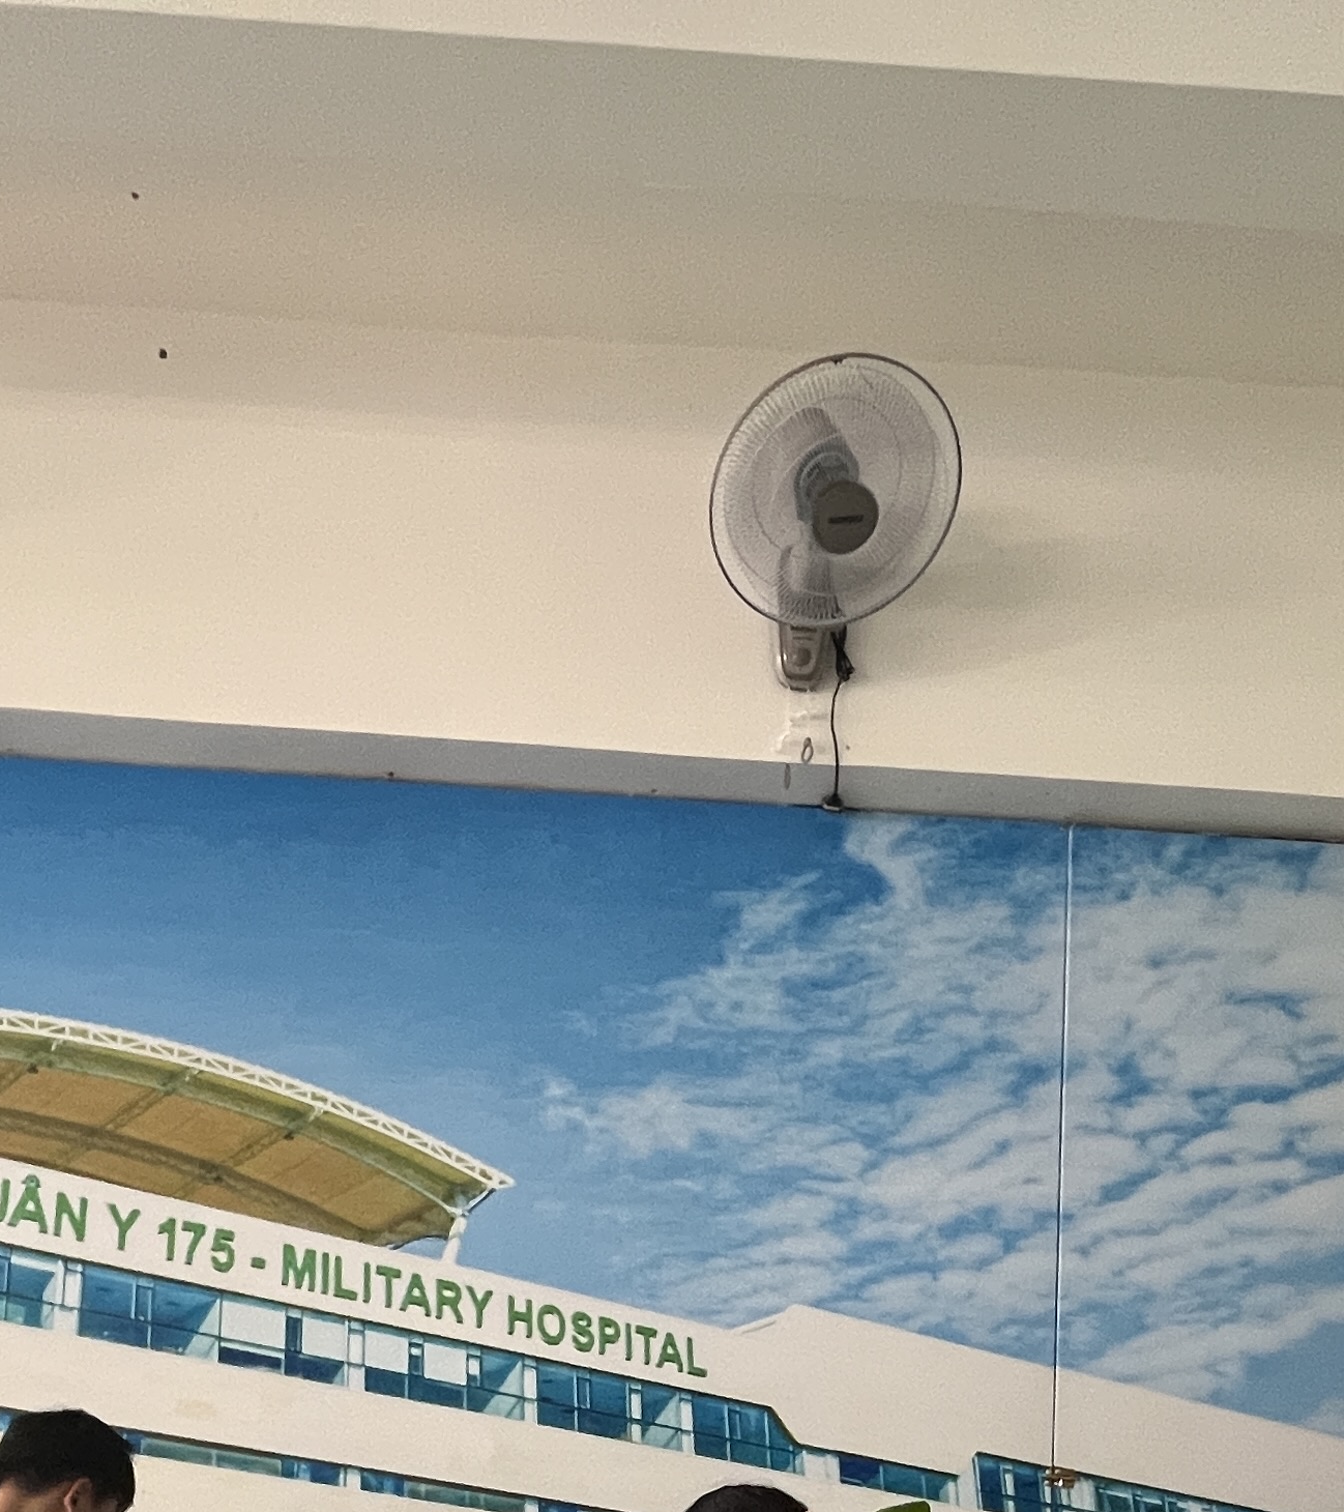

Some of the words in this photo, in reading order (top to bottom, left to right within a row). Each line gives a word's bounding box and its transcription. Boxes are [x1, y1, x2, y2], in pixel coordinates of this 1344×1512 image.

[105, 1202, 141, 1251] Y
[156, 1217, 237, 1273] 175
[280, 1243, 494, 1329] MILITARY
[507, 1294, 709, 1378] HOSPITAL
